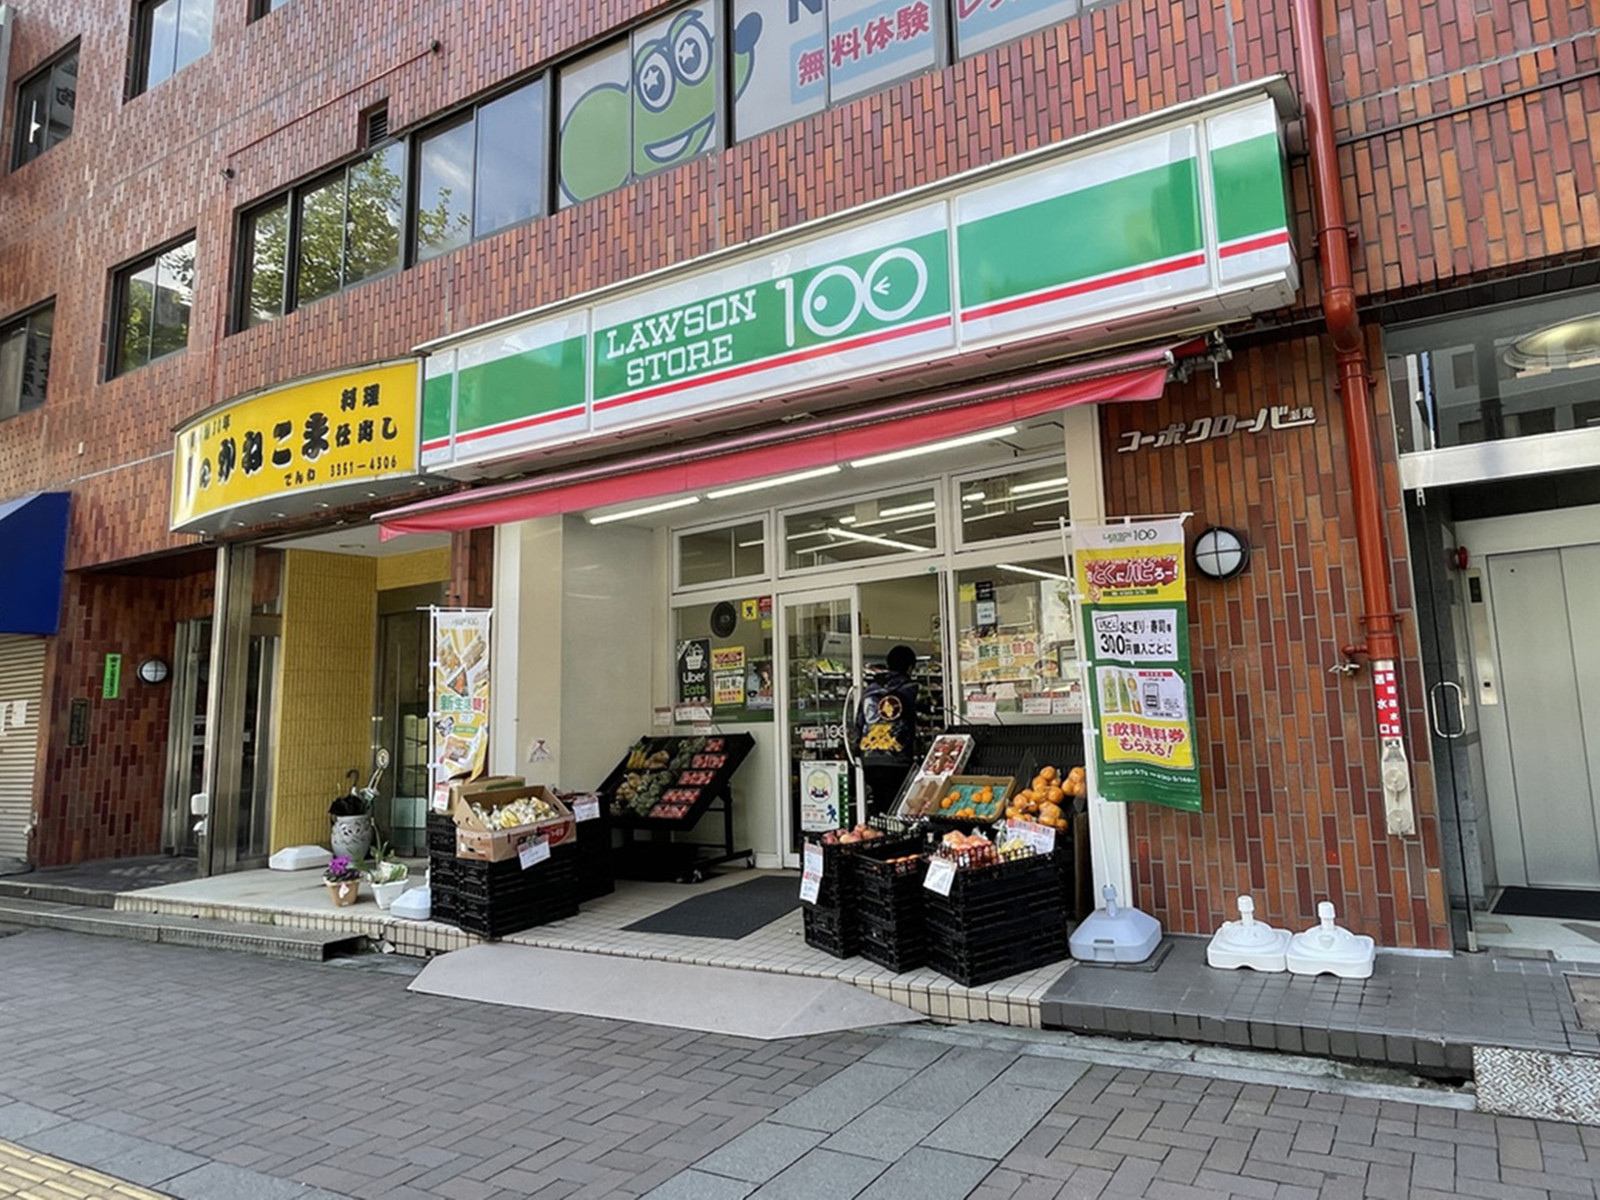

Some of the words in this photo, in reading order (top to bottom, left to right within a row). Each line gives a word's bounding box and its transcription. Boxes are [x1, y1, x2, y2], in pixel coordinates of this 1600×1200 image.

[797, 1, 931, 87] 無料体験
[775, 247, 928, 347] 100
[606, 289, 757, 360] LAWSON
[626, 333, 733, 387] STORE
[340, 383, 381, 412] 料理
[336, 416, 398, 448] 仕出し
[284, 468, 316, 487] でんわ
[1133, 528, 1158, 541] 100
[682, 672, 706, 684] Uber
[683, 683, 706, 696] Eats
[1119, 737, 1173, 758] もらえる!
